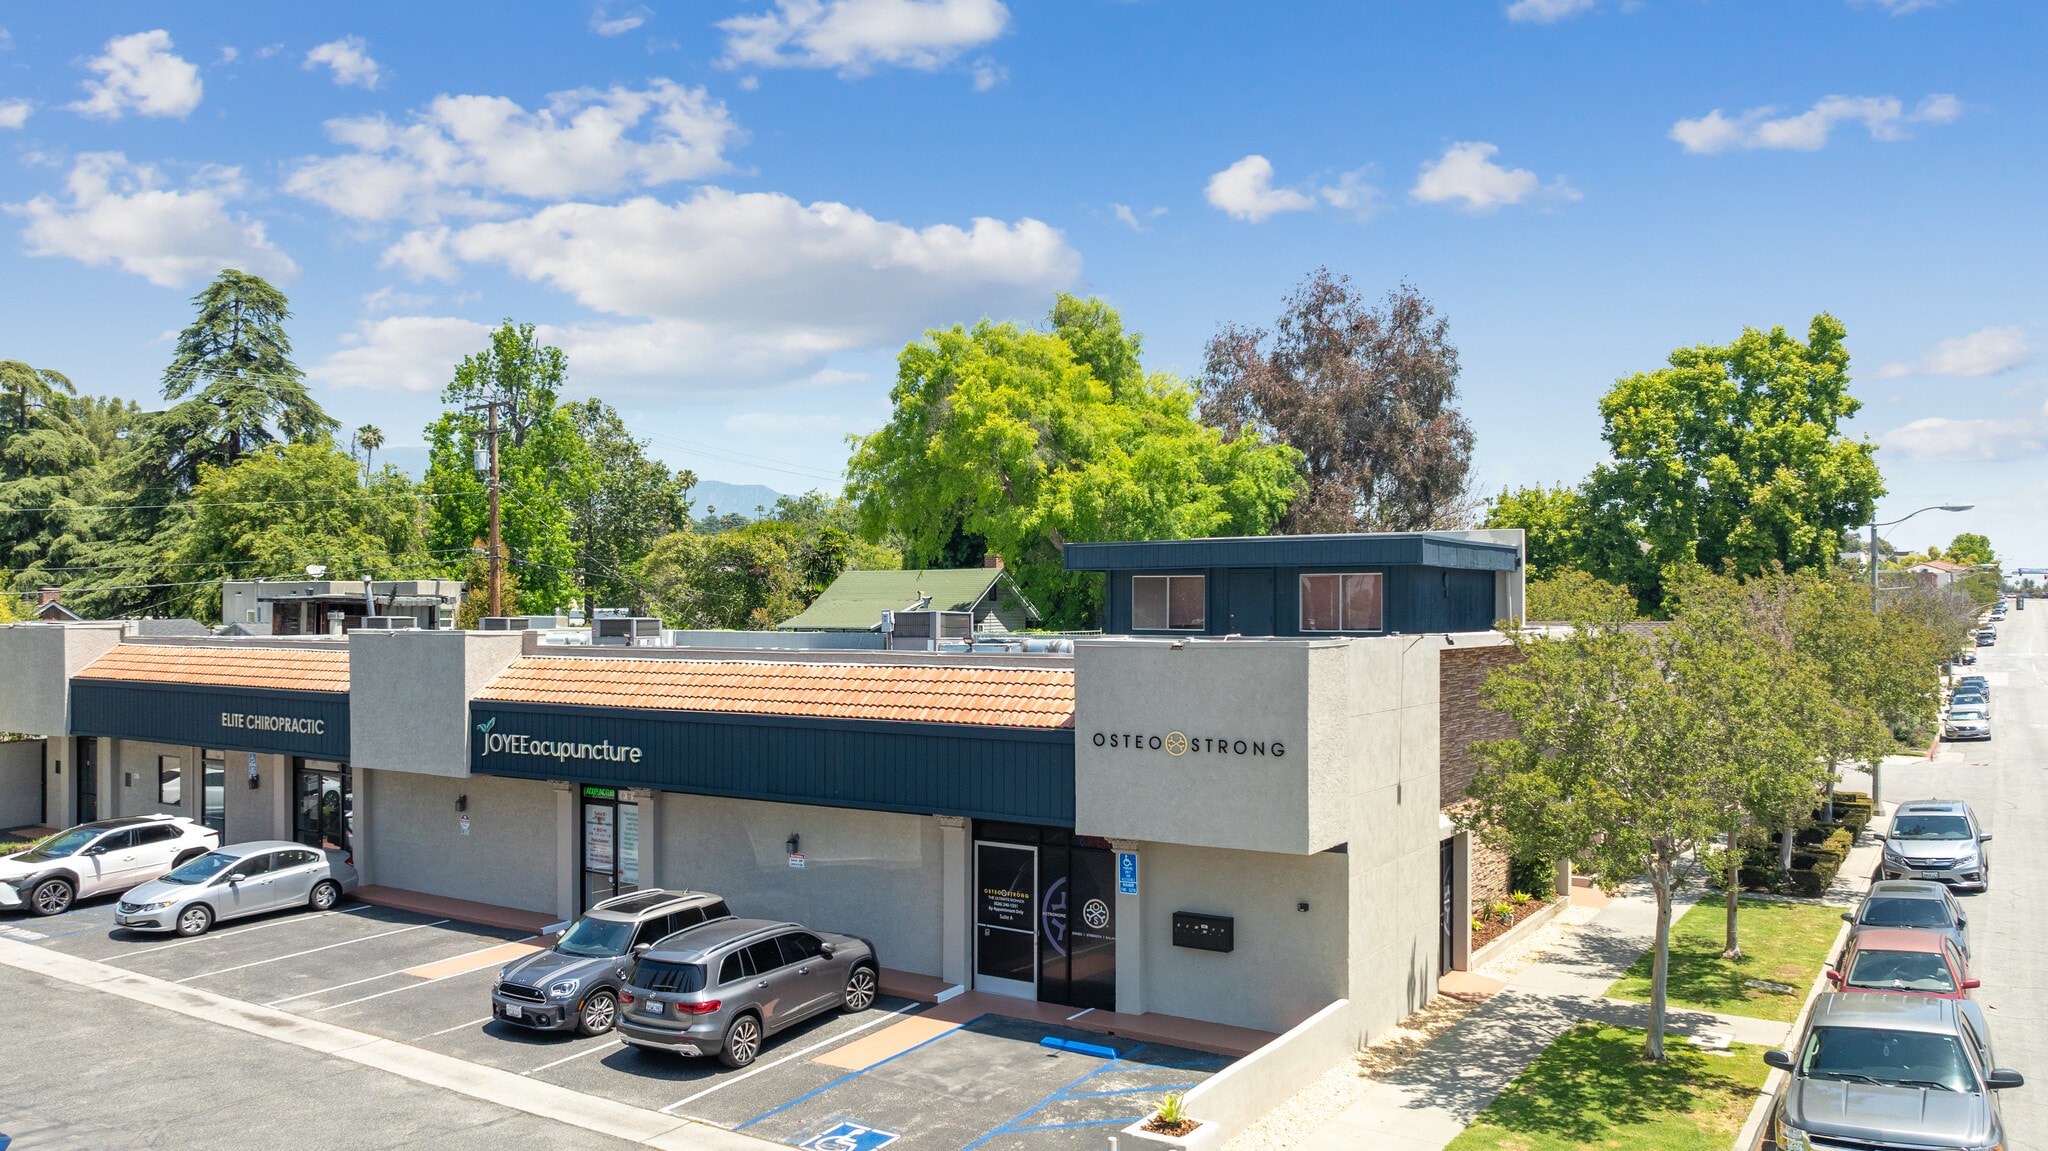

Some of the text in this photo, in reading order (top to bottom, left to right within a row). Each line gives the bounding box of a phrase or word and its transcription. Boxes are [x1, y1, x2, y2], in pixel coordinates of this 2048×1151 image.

[222, 712, 325, 735] ELITE CHIROPRACTIC
[1093, 733, 1285, 757] OSTEO STRONG
